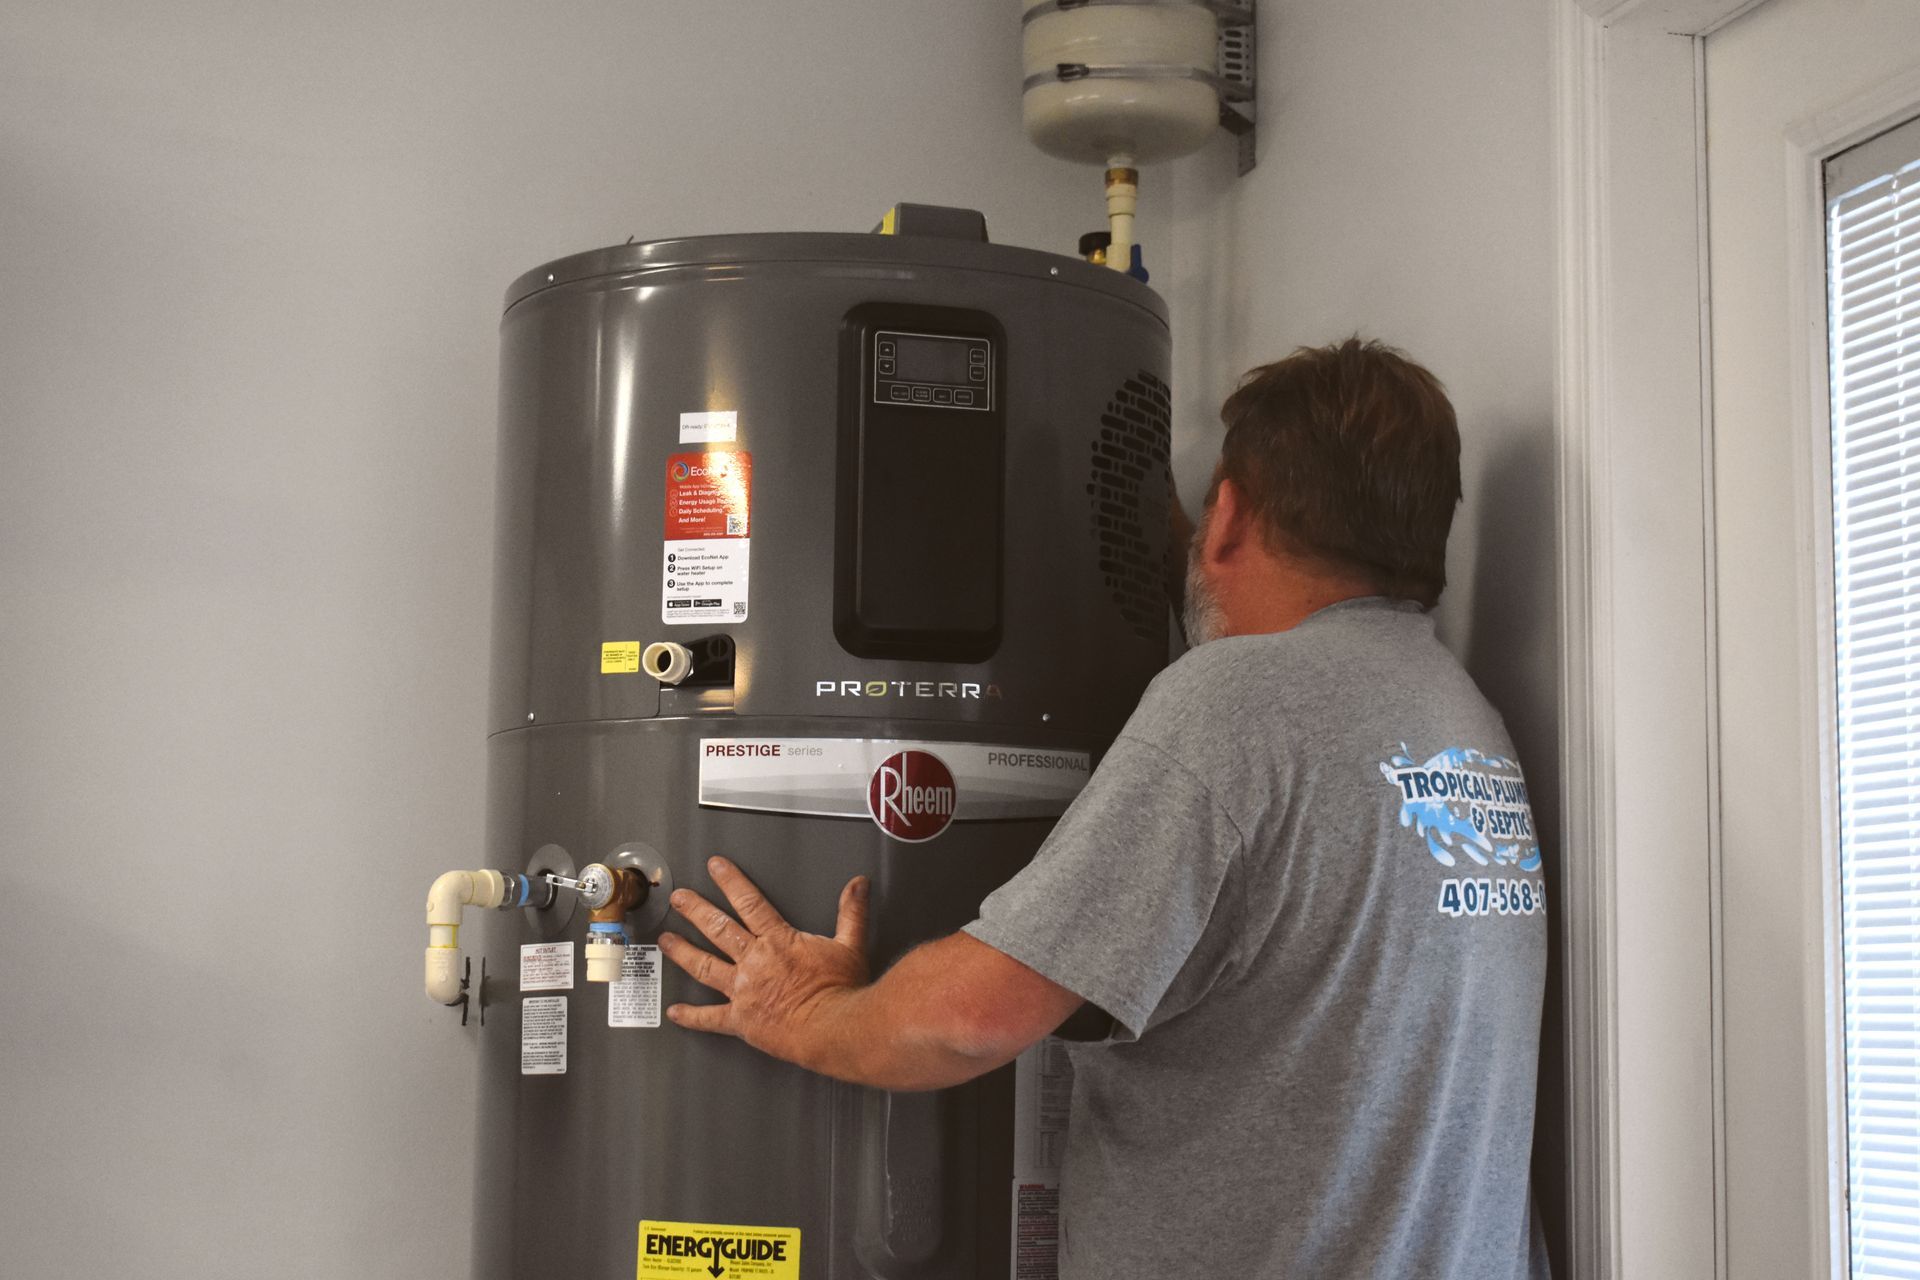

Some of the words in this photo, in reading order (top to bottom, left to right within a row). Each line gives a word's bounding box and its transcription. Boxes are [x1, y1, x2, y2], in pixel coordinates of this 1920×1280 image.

[816, 681, 1001, 699] PROTERRA
[706, 744, 781, 757] PRESTIGE
[787, 746, 823, 757] series
[988, 752, 1088, 771] PROFESSIONAL
[880, 752, 954, 827] Rheem
[1397, 770, 1491, 802] TROPICAL
[1471, 807, 1485, 833] &
[1487, 808, 1531, 836] SEPTIC
[646, 1233, 787, 1261] ENERGYGUIDE
